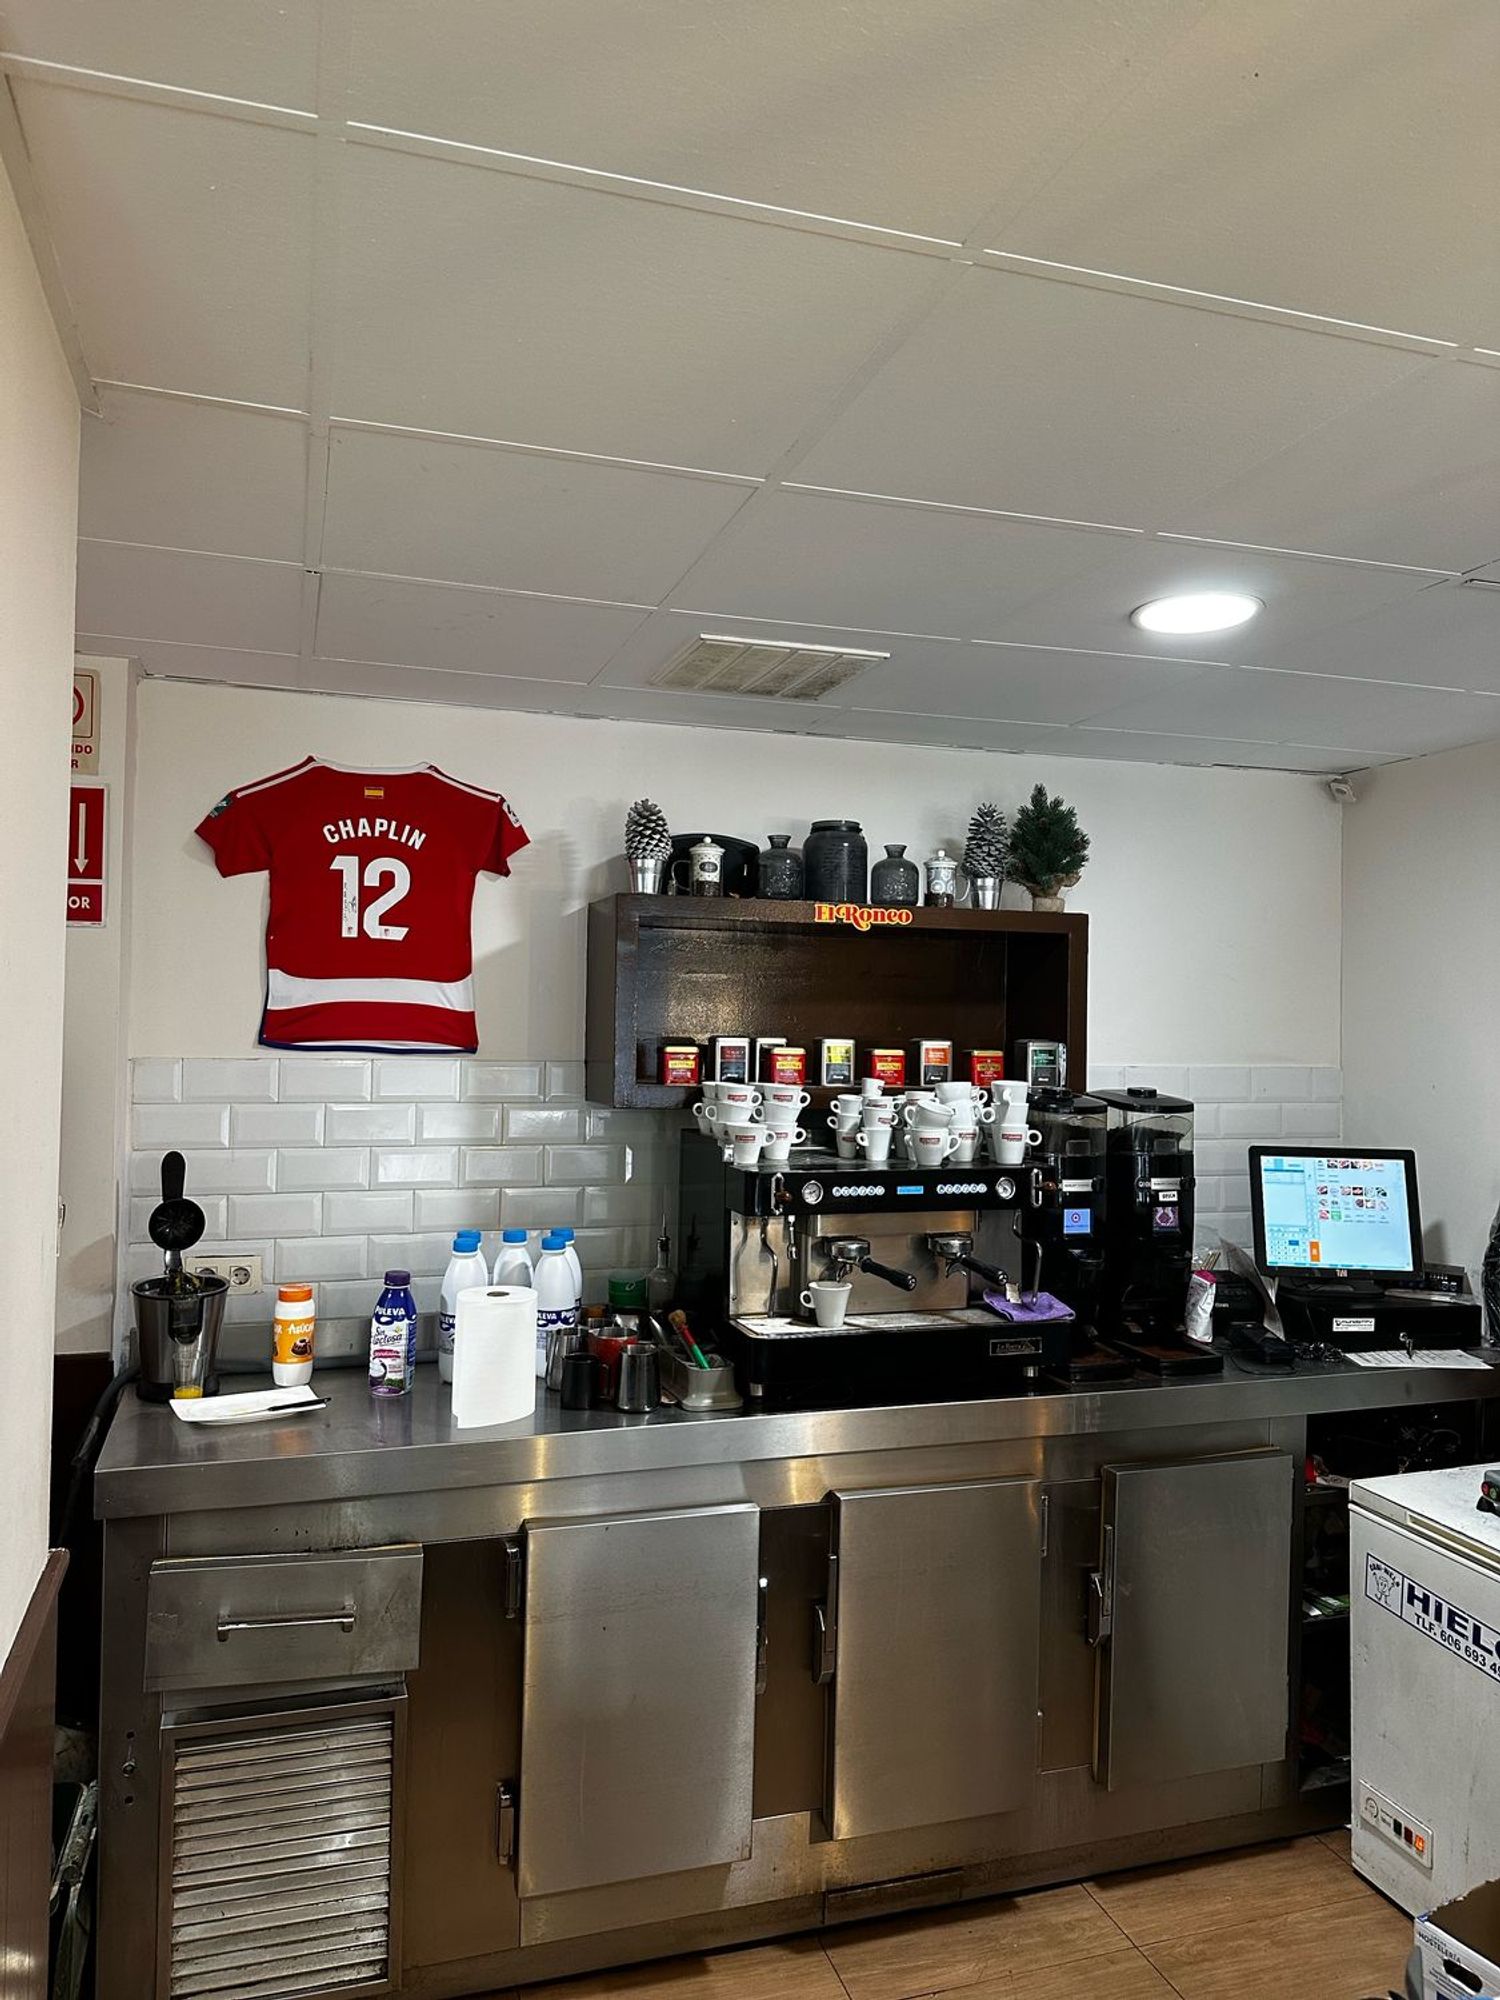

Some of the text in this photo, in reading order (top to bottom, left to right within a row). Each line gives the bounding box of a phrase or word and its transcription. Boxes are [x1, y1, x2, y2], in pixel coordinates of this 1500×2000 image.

[322, 817, 427, 851] CHAPLIN
[68, 896, 91, 909] OR
[329, 854, 411, 941] 12
[814, 903, 836, 922] El
[374, 1304, 406, 1317] PULEVA
[1414, 1612, 1438, 1637] TLF.
[1440, 1629, 1462, 1652] 606
[1464, 1644, 1488, 1668] 693
